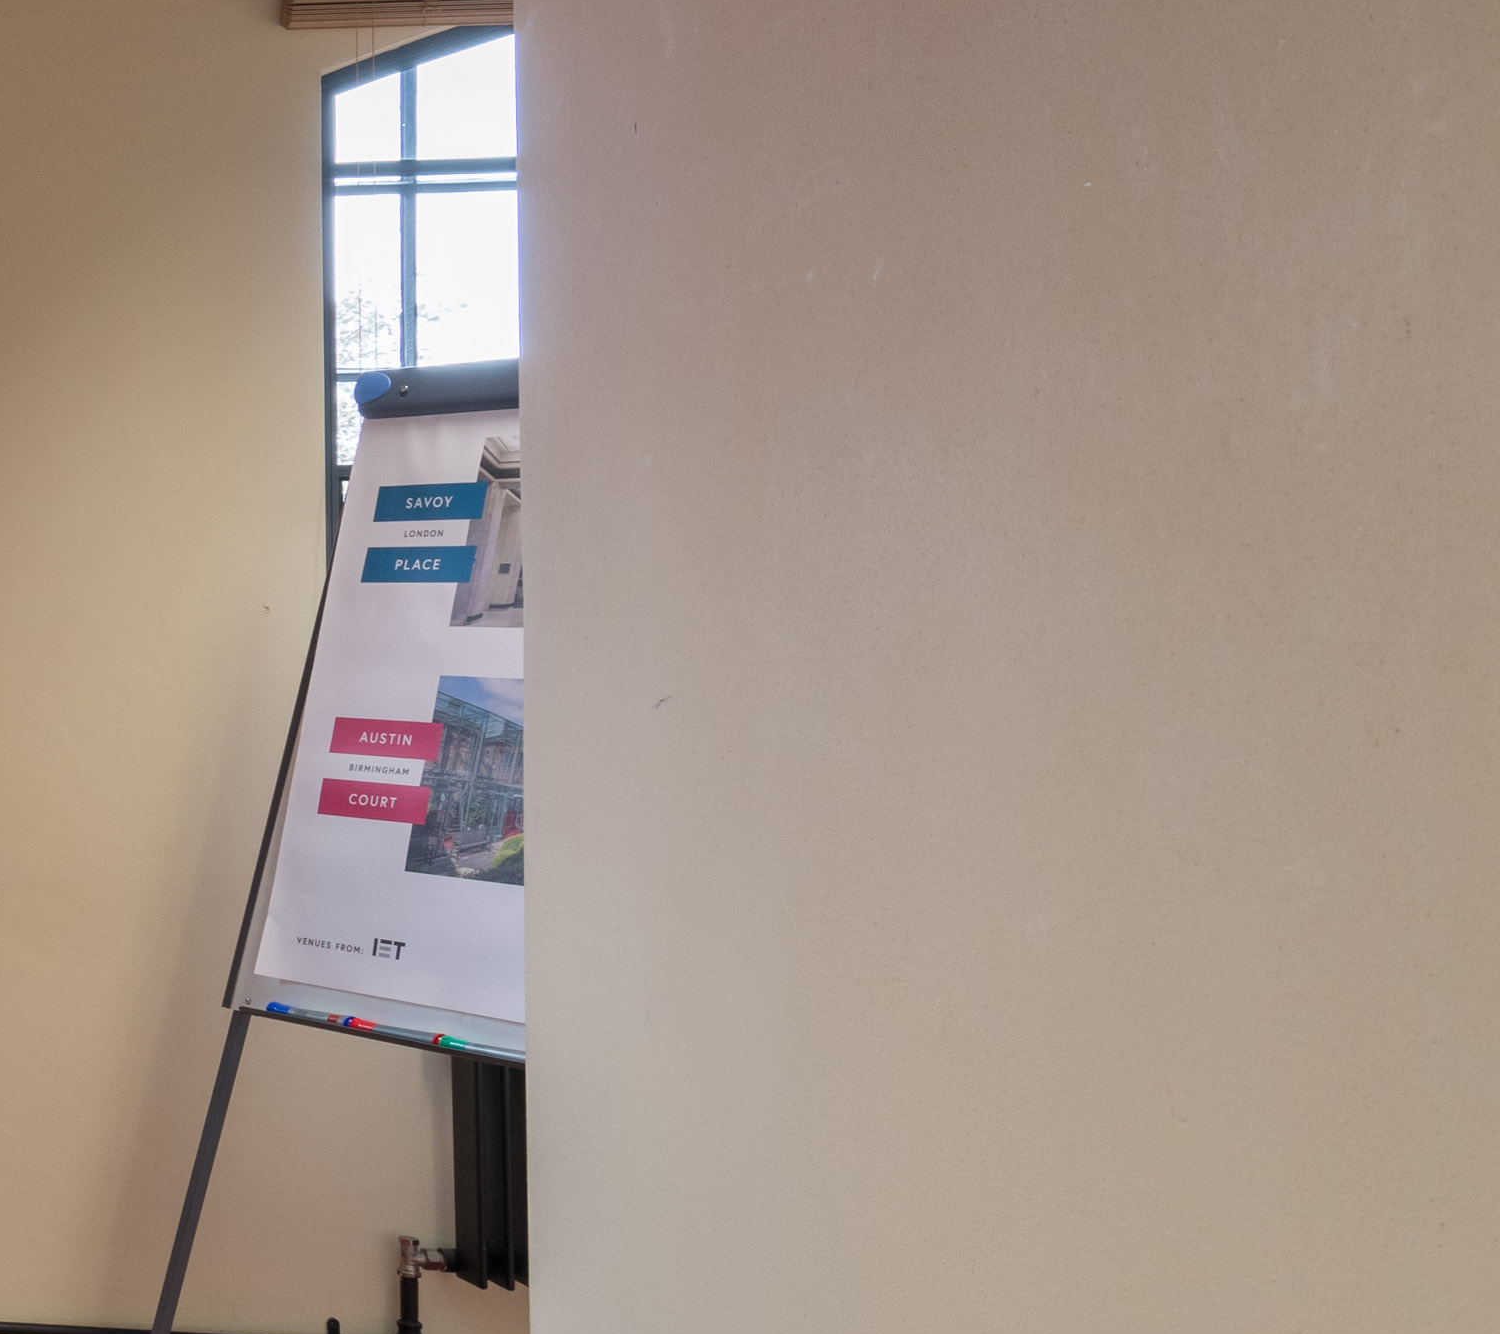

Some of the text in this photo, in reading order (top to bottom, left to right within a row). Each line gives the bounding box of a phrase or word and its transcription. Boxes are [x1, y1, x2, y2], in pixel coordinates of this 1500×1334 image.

[405, 495, 454, 509] SAVOY
[403, 529, 445, 538] LONDON
[394, 558, 442, 571] PLACE
[358, 731, 413, 747] AUSTIN
[348, 763, 411, 776] BIRMINGHAM
[348, 793, 398, 809] COURT
[296, 936, 407, 961] VENUES FROM: IET
